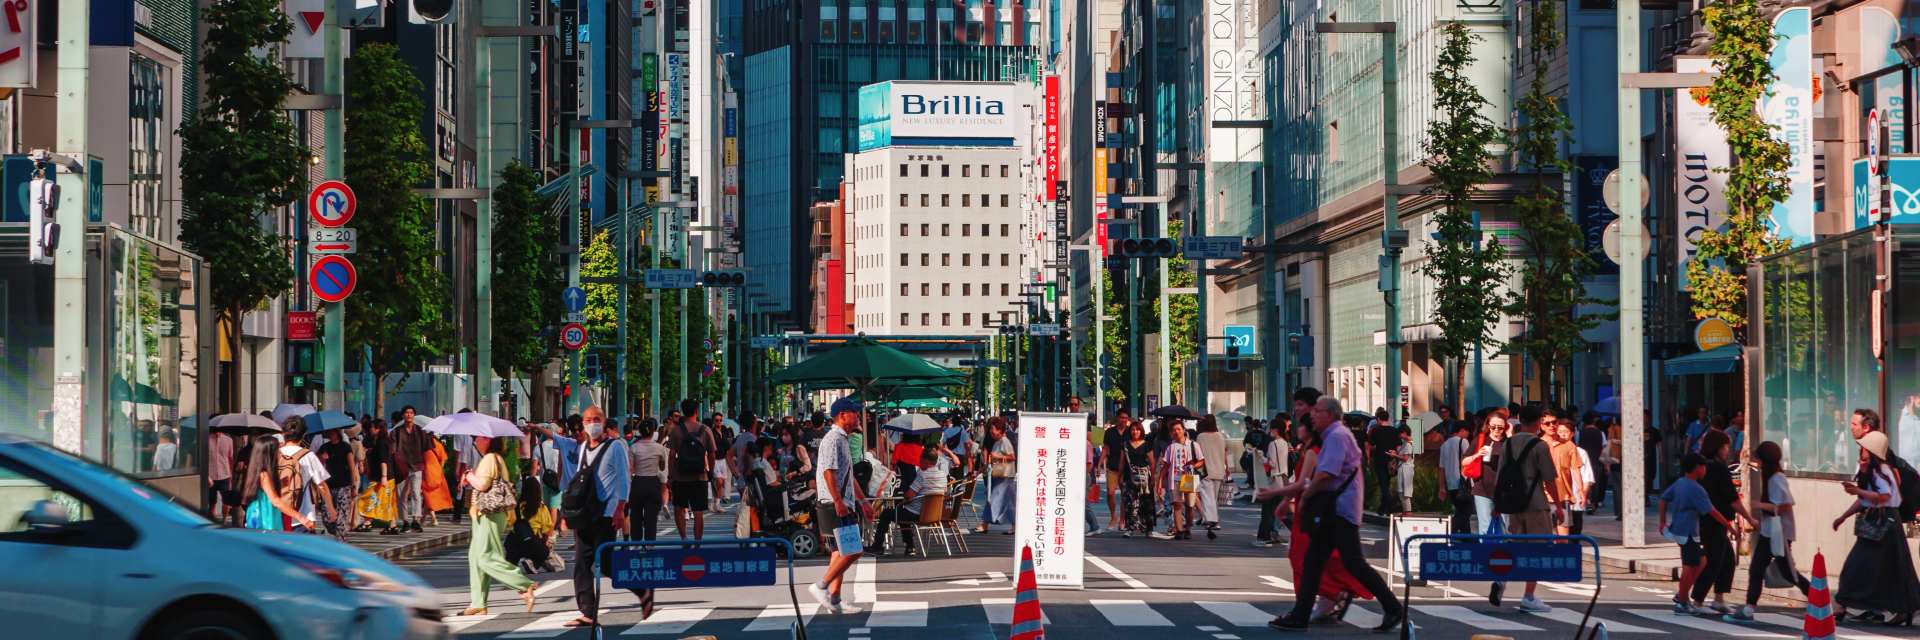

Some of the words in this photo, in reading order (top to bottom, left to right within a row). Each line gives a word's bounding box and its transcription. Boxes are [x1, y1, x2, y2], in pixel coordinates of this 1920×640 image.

[901, 95, 1005, 115] Brillia
[1048, 125, 1057, 181] 銀座アスター
[567, 330, 582, 342] 50
[1034, 426, 1047, 439] 警
[1059, 427, 1071, 440] 告
[1437, 549, 1472, 561] 自転車
[629, 557, 665, 569] 自転車
[709, 560, 769, 574] 築地警察署
[617, 570, 678, 582] 乗入れ禁止
